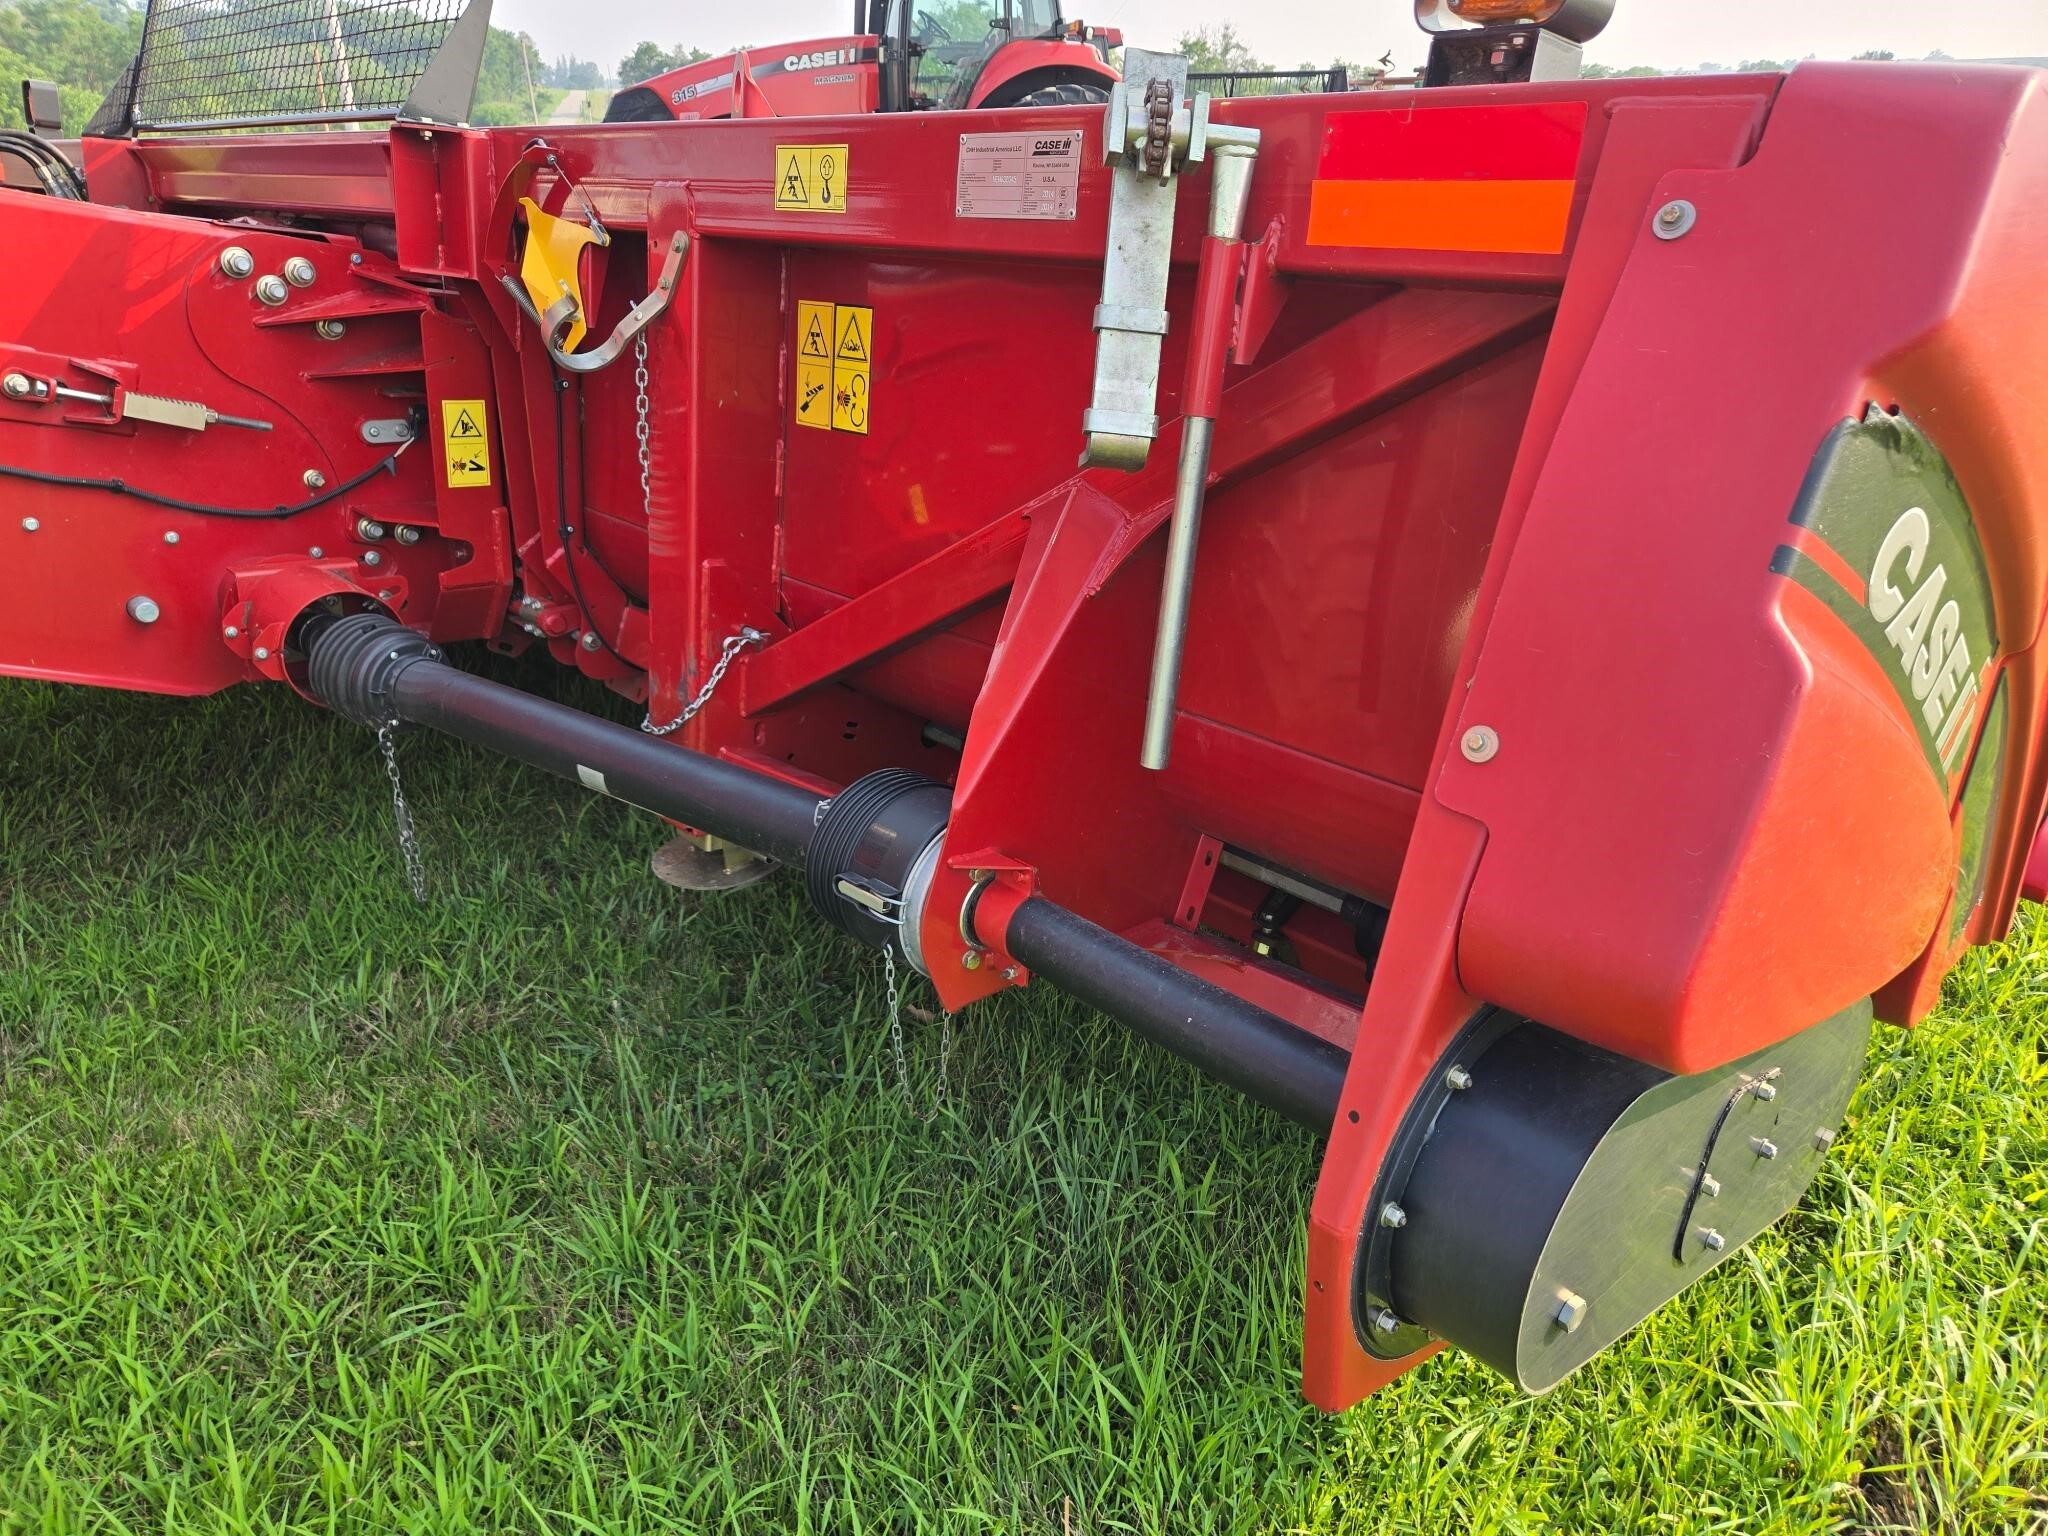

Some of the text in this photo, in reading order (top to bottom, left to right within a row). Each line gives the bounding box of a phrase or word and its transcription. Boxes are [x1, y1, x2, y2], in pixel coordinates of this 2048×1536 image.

[783, 52, 837, 71] CASE
[814, 73, 856, 86] MAGNUM
[672, 84, 697, 105] 315
[1034, 140, 1062, 150] CASE
[1867, 506, 1971, 737] CASE
